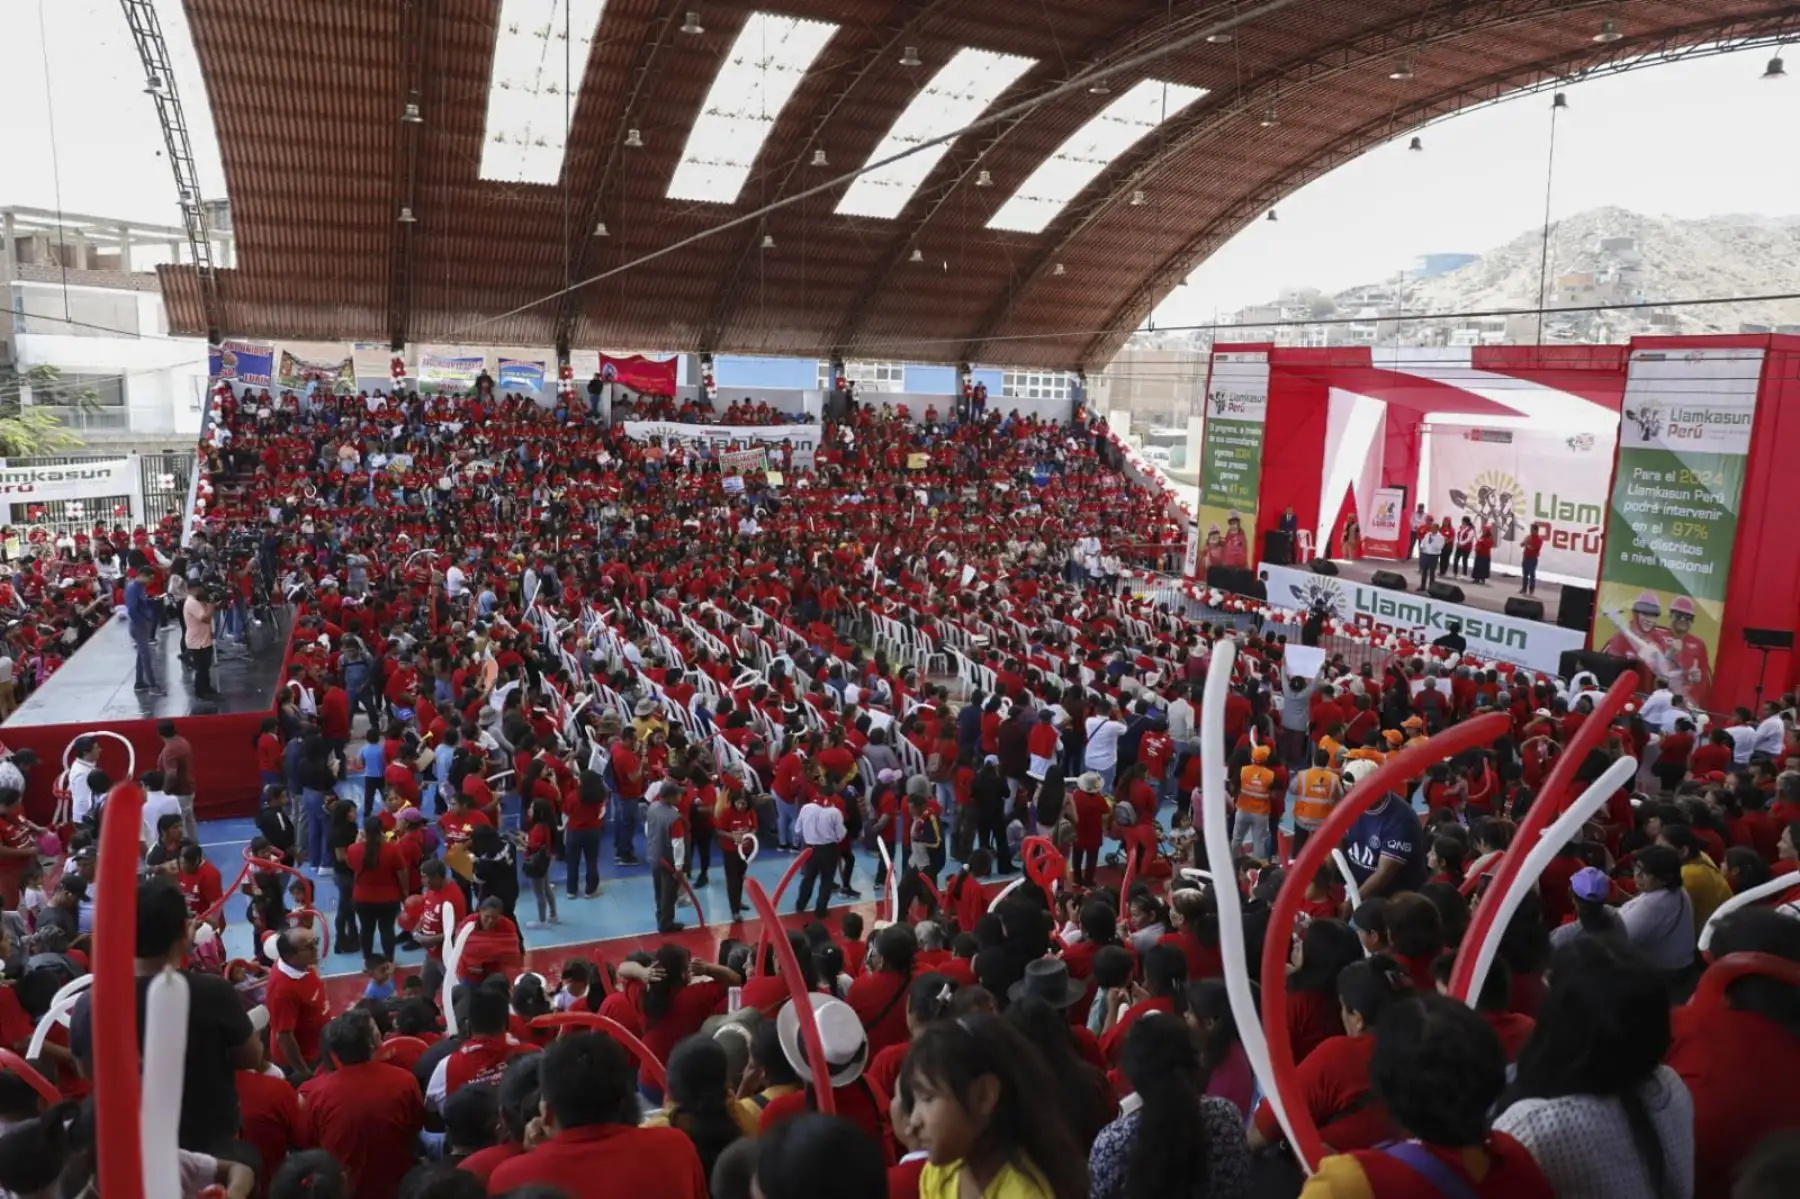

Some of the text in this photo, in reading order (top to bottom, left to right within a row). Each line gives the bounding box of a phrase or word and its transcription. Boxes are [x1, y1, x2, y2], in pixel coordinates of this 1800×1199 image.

[1670, 408, 1752, 425] Llamkasun
[1667, 424, 1703, 439] Perú
[0, 469, 111, 482] mkasun
[1633, 467, 1723, 486] Para el 2024
[1627, 484, 1725, 504] Llamkasun Perú
[1534, 492, 1600, 524] Llam
[1663, 502, 1723, 520] intervenir
[1534, 520, 1601, 554] Perú
[1632, 521, 1708, 540] en el 97%
[1632, 536, 1703, 556] de distritos
[1631, 552, 1656, 566] nivel
[1659, 557, 1714, 574] nacional
[1355, 588, 1527, 649] Llamkasun
[1387, 839, 1412, 853] QNB
